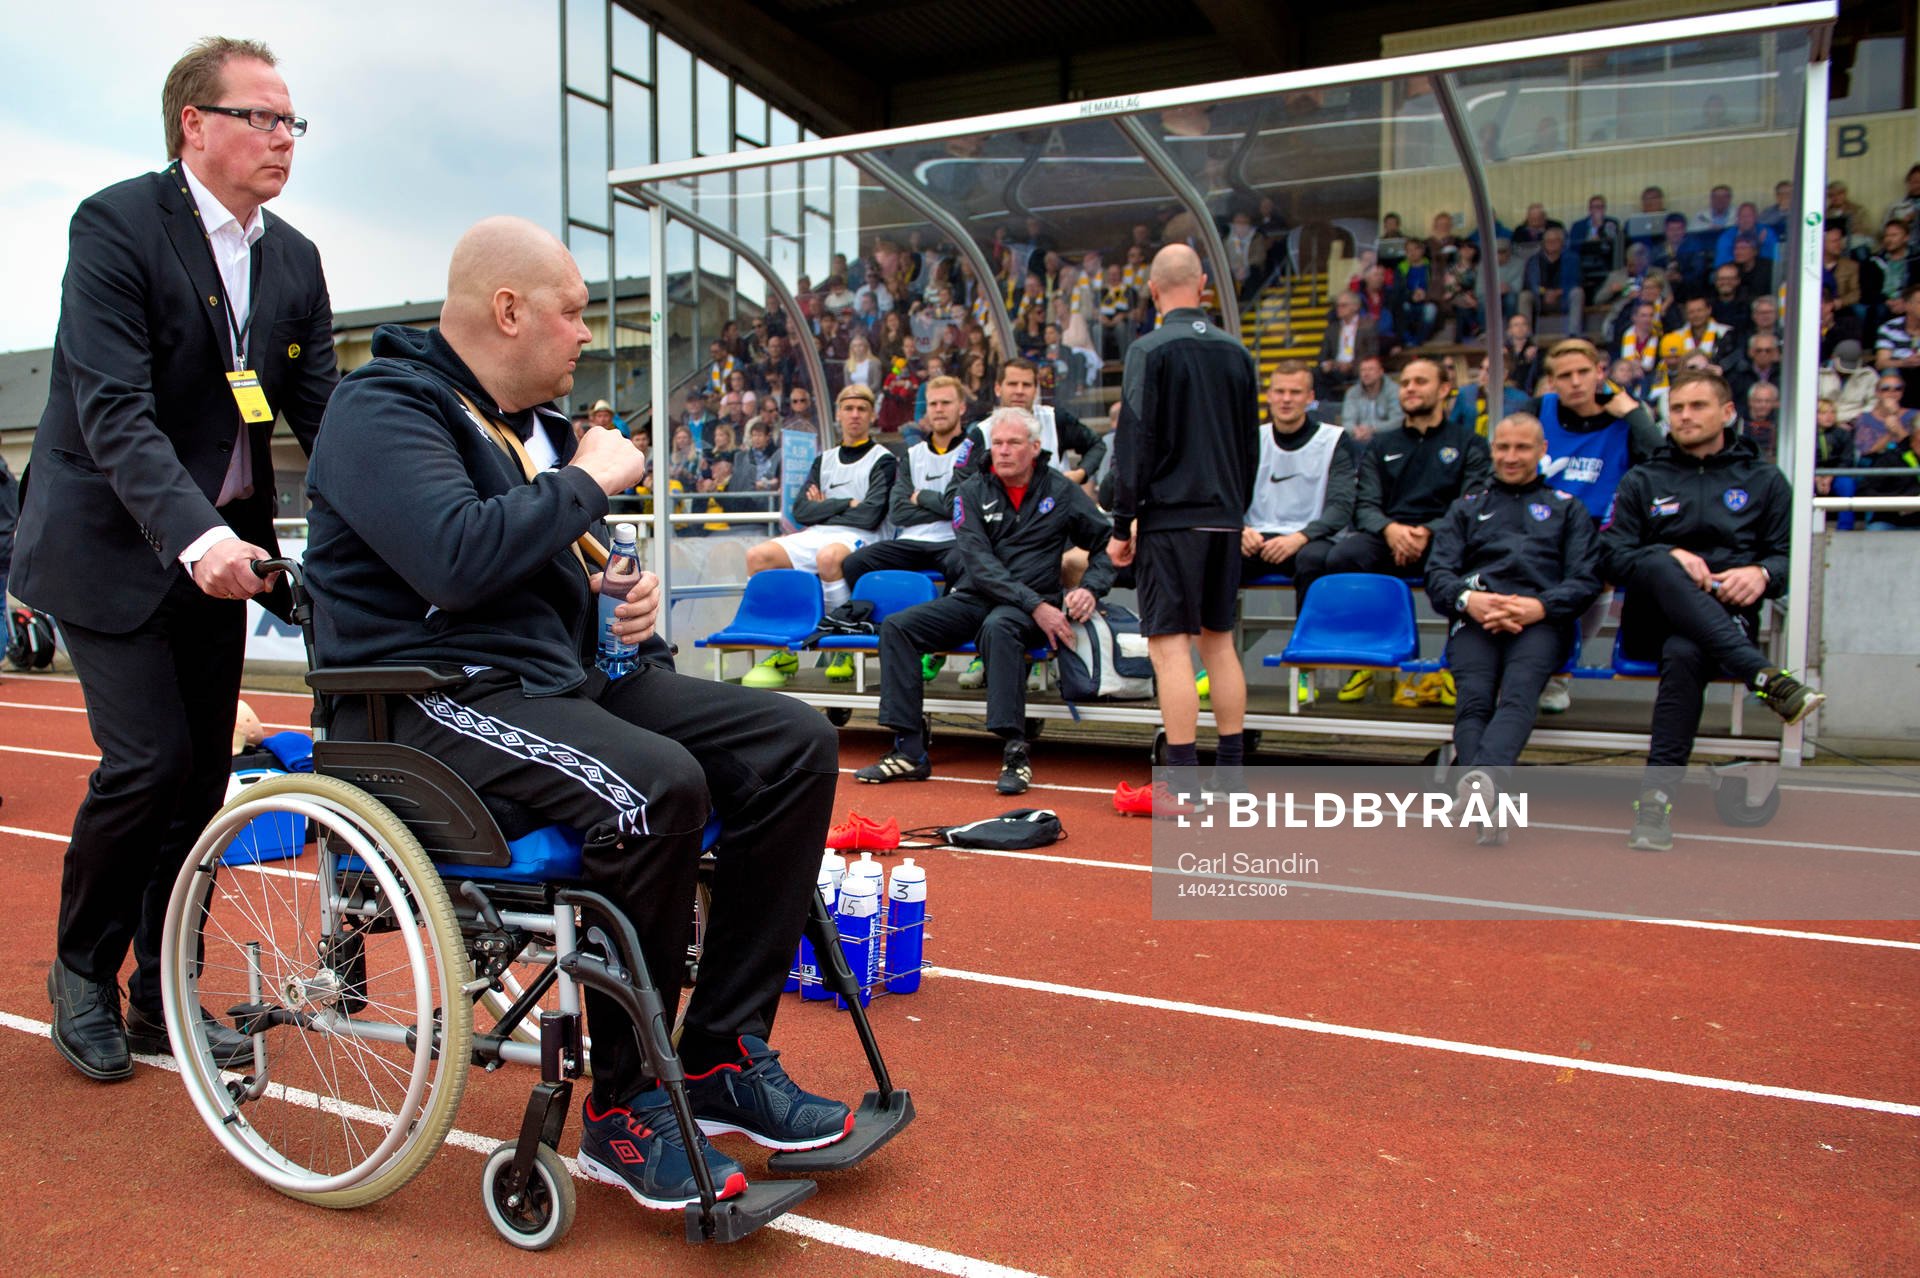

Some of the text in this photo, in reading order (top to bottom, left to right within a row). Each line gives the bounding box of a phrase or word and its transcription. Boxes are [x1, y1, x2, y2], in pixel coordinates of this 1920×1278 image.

[1080, 96, 1140, 114] HEMMALAG
[1837, 124, 1869, 159] B
[893, 884, 909, 900] 3
[841, 897, 861, 916] 15
